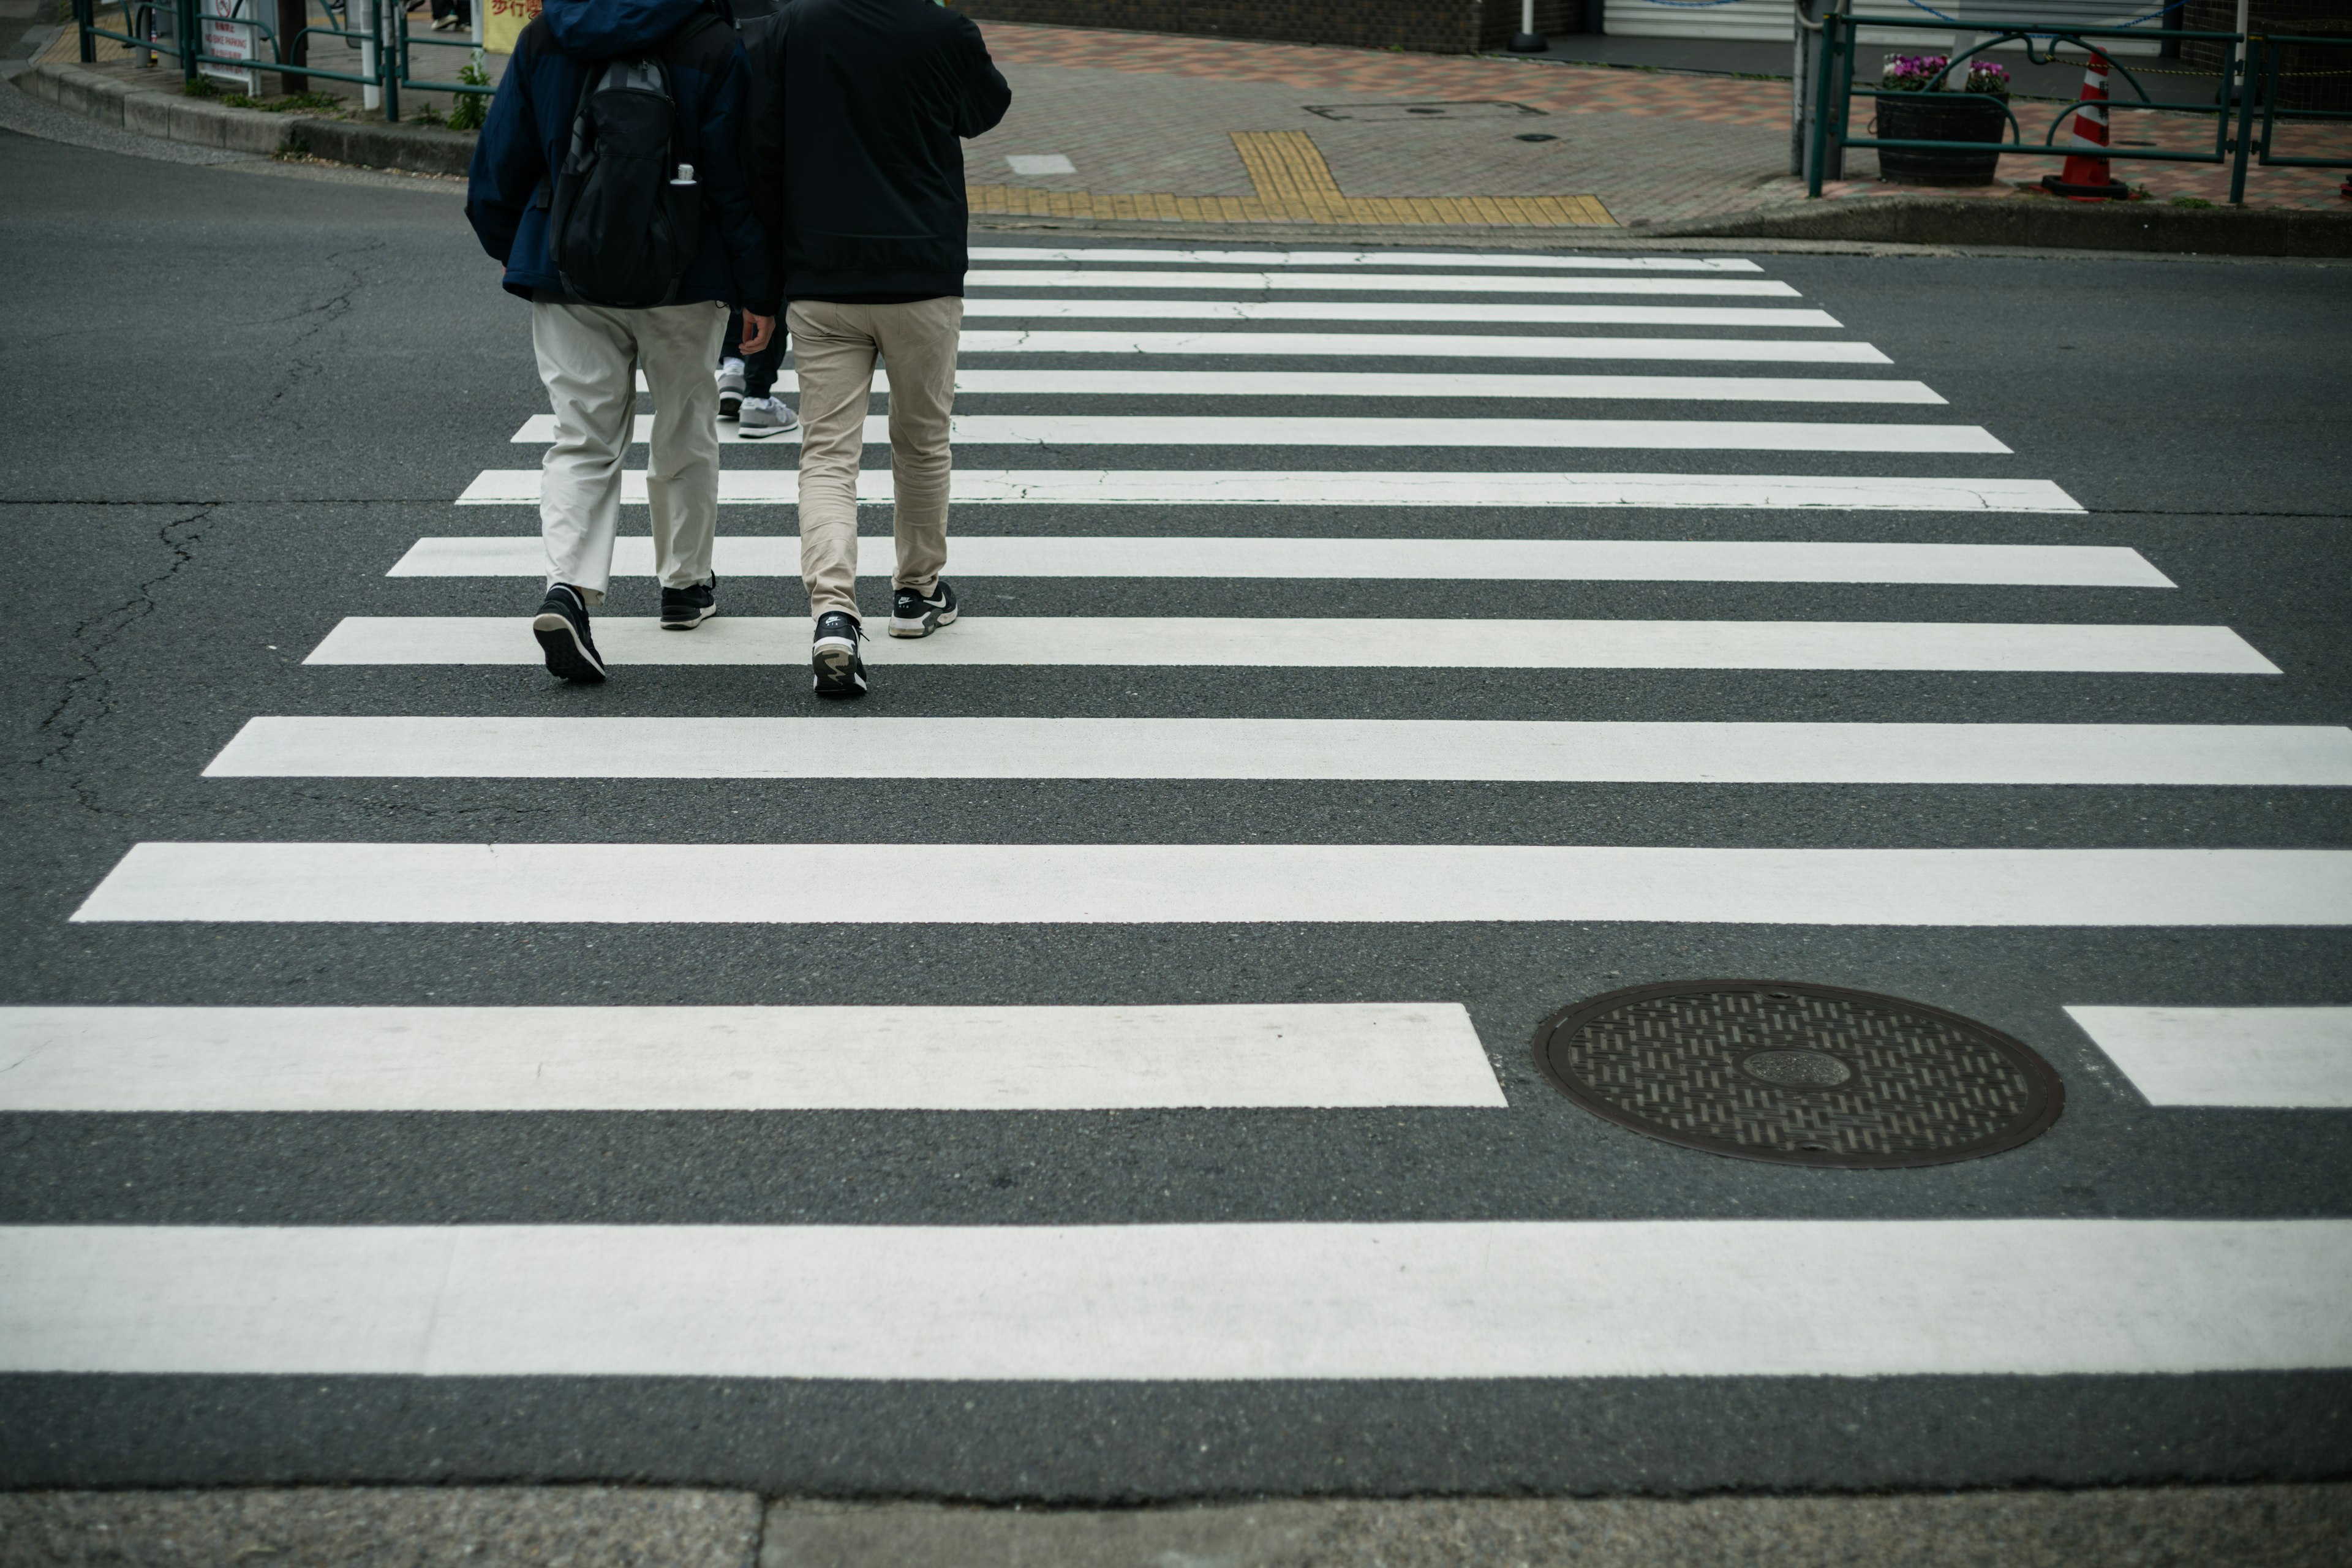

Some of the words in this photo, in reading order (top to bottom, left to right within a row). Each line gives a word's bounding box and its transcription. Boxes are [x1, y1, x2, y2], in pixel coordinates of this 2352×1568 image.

[205, 34, 211, 43] NO
[213, 34, 224, 44] BIKE
[225, 36, 247, 49] PARKING
